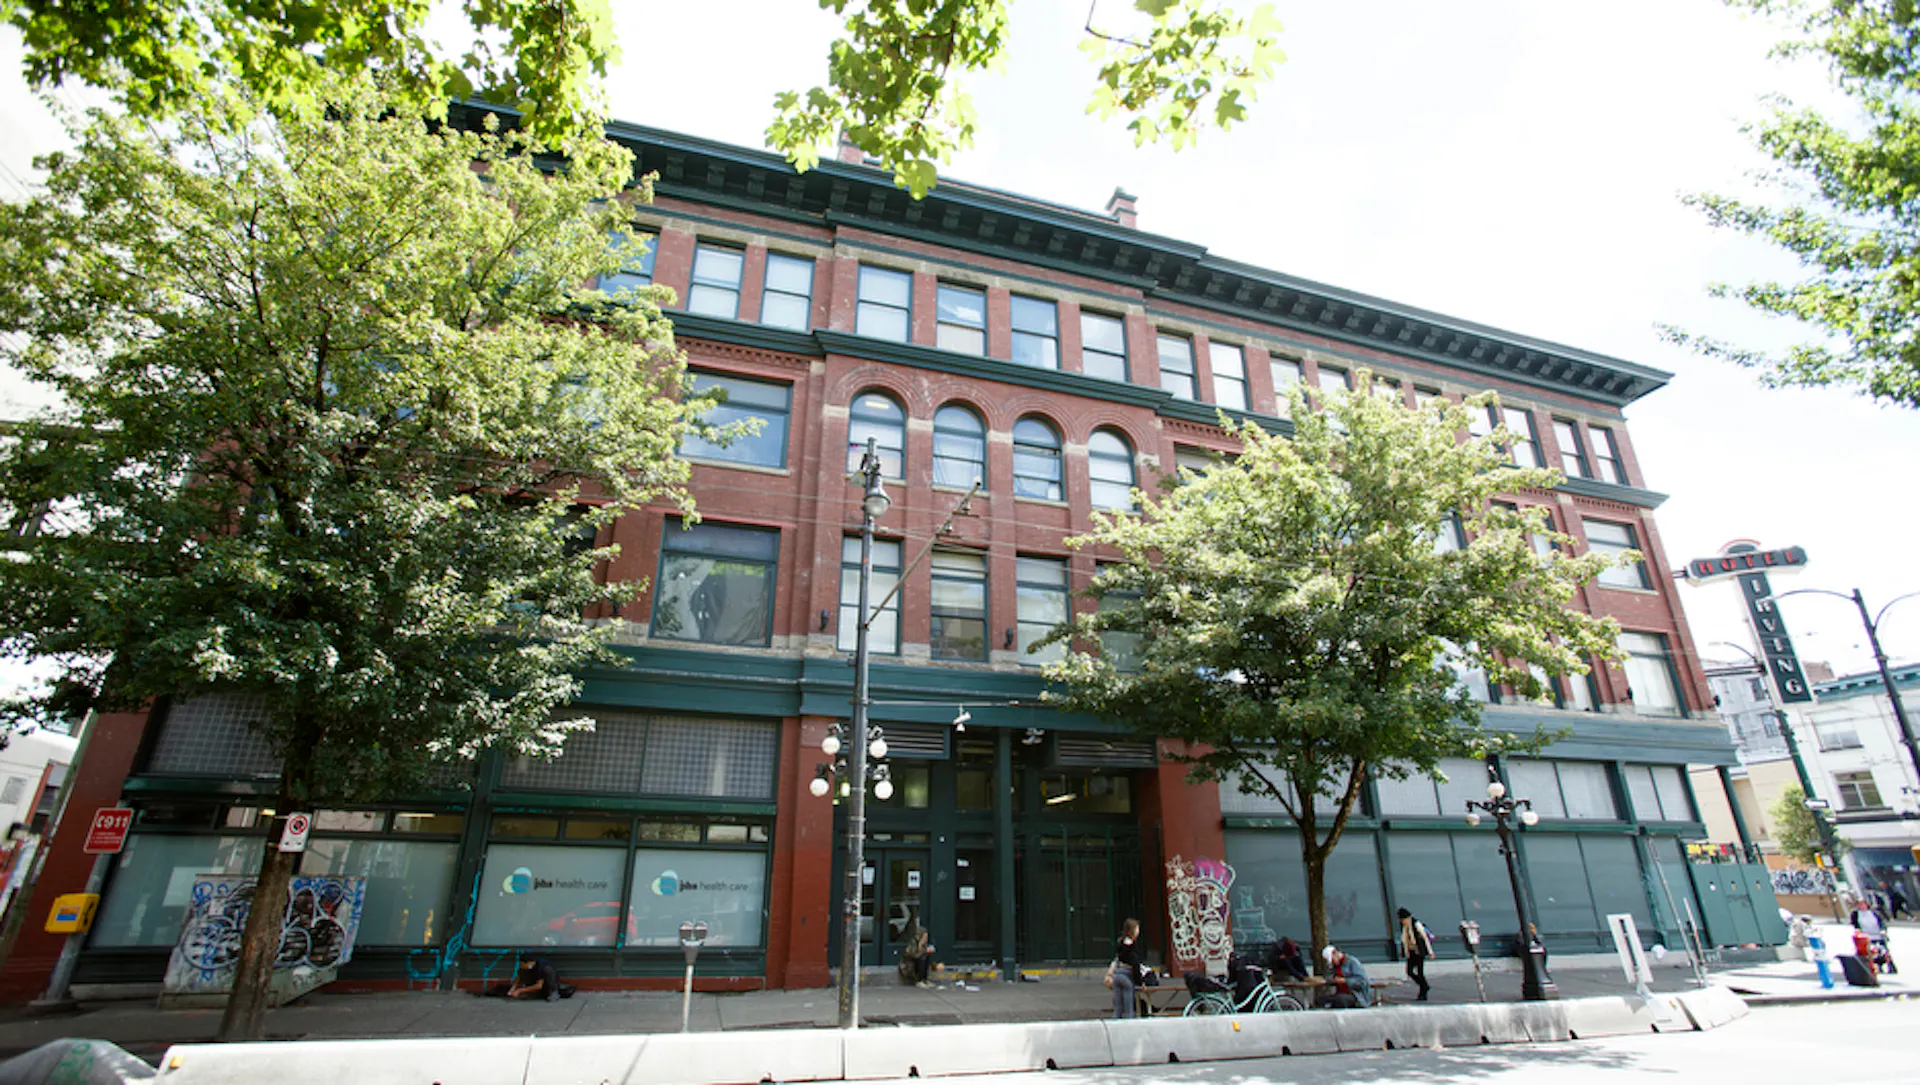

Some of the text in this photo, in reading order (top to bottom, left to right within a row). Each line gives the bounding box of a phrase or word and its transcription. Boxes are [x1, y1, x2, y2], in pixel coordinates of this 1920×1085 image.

[1698, 551, 1800, 575] HOTEL
[1751, 579, 1802, 694] IRVING
[556, 878, 585, 890] health
[587, 880, 608, 890] care
[700, 880, 727, 891] health
[730, 882, 749, 892] care
